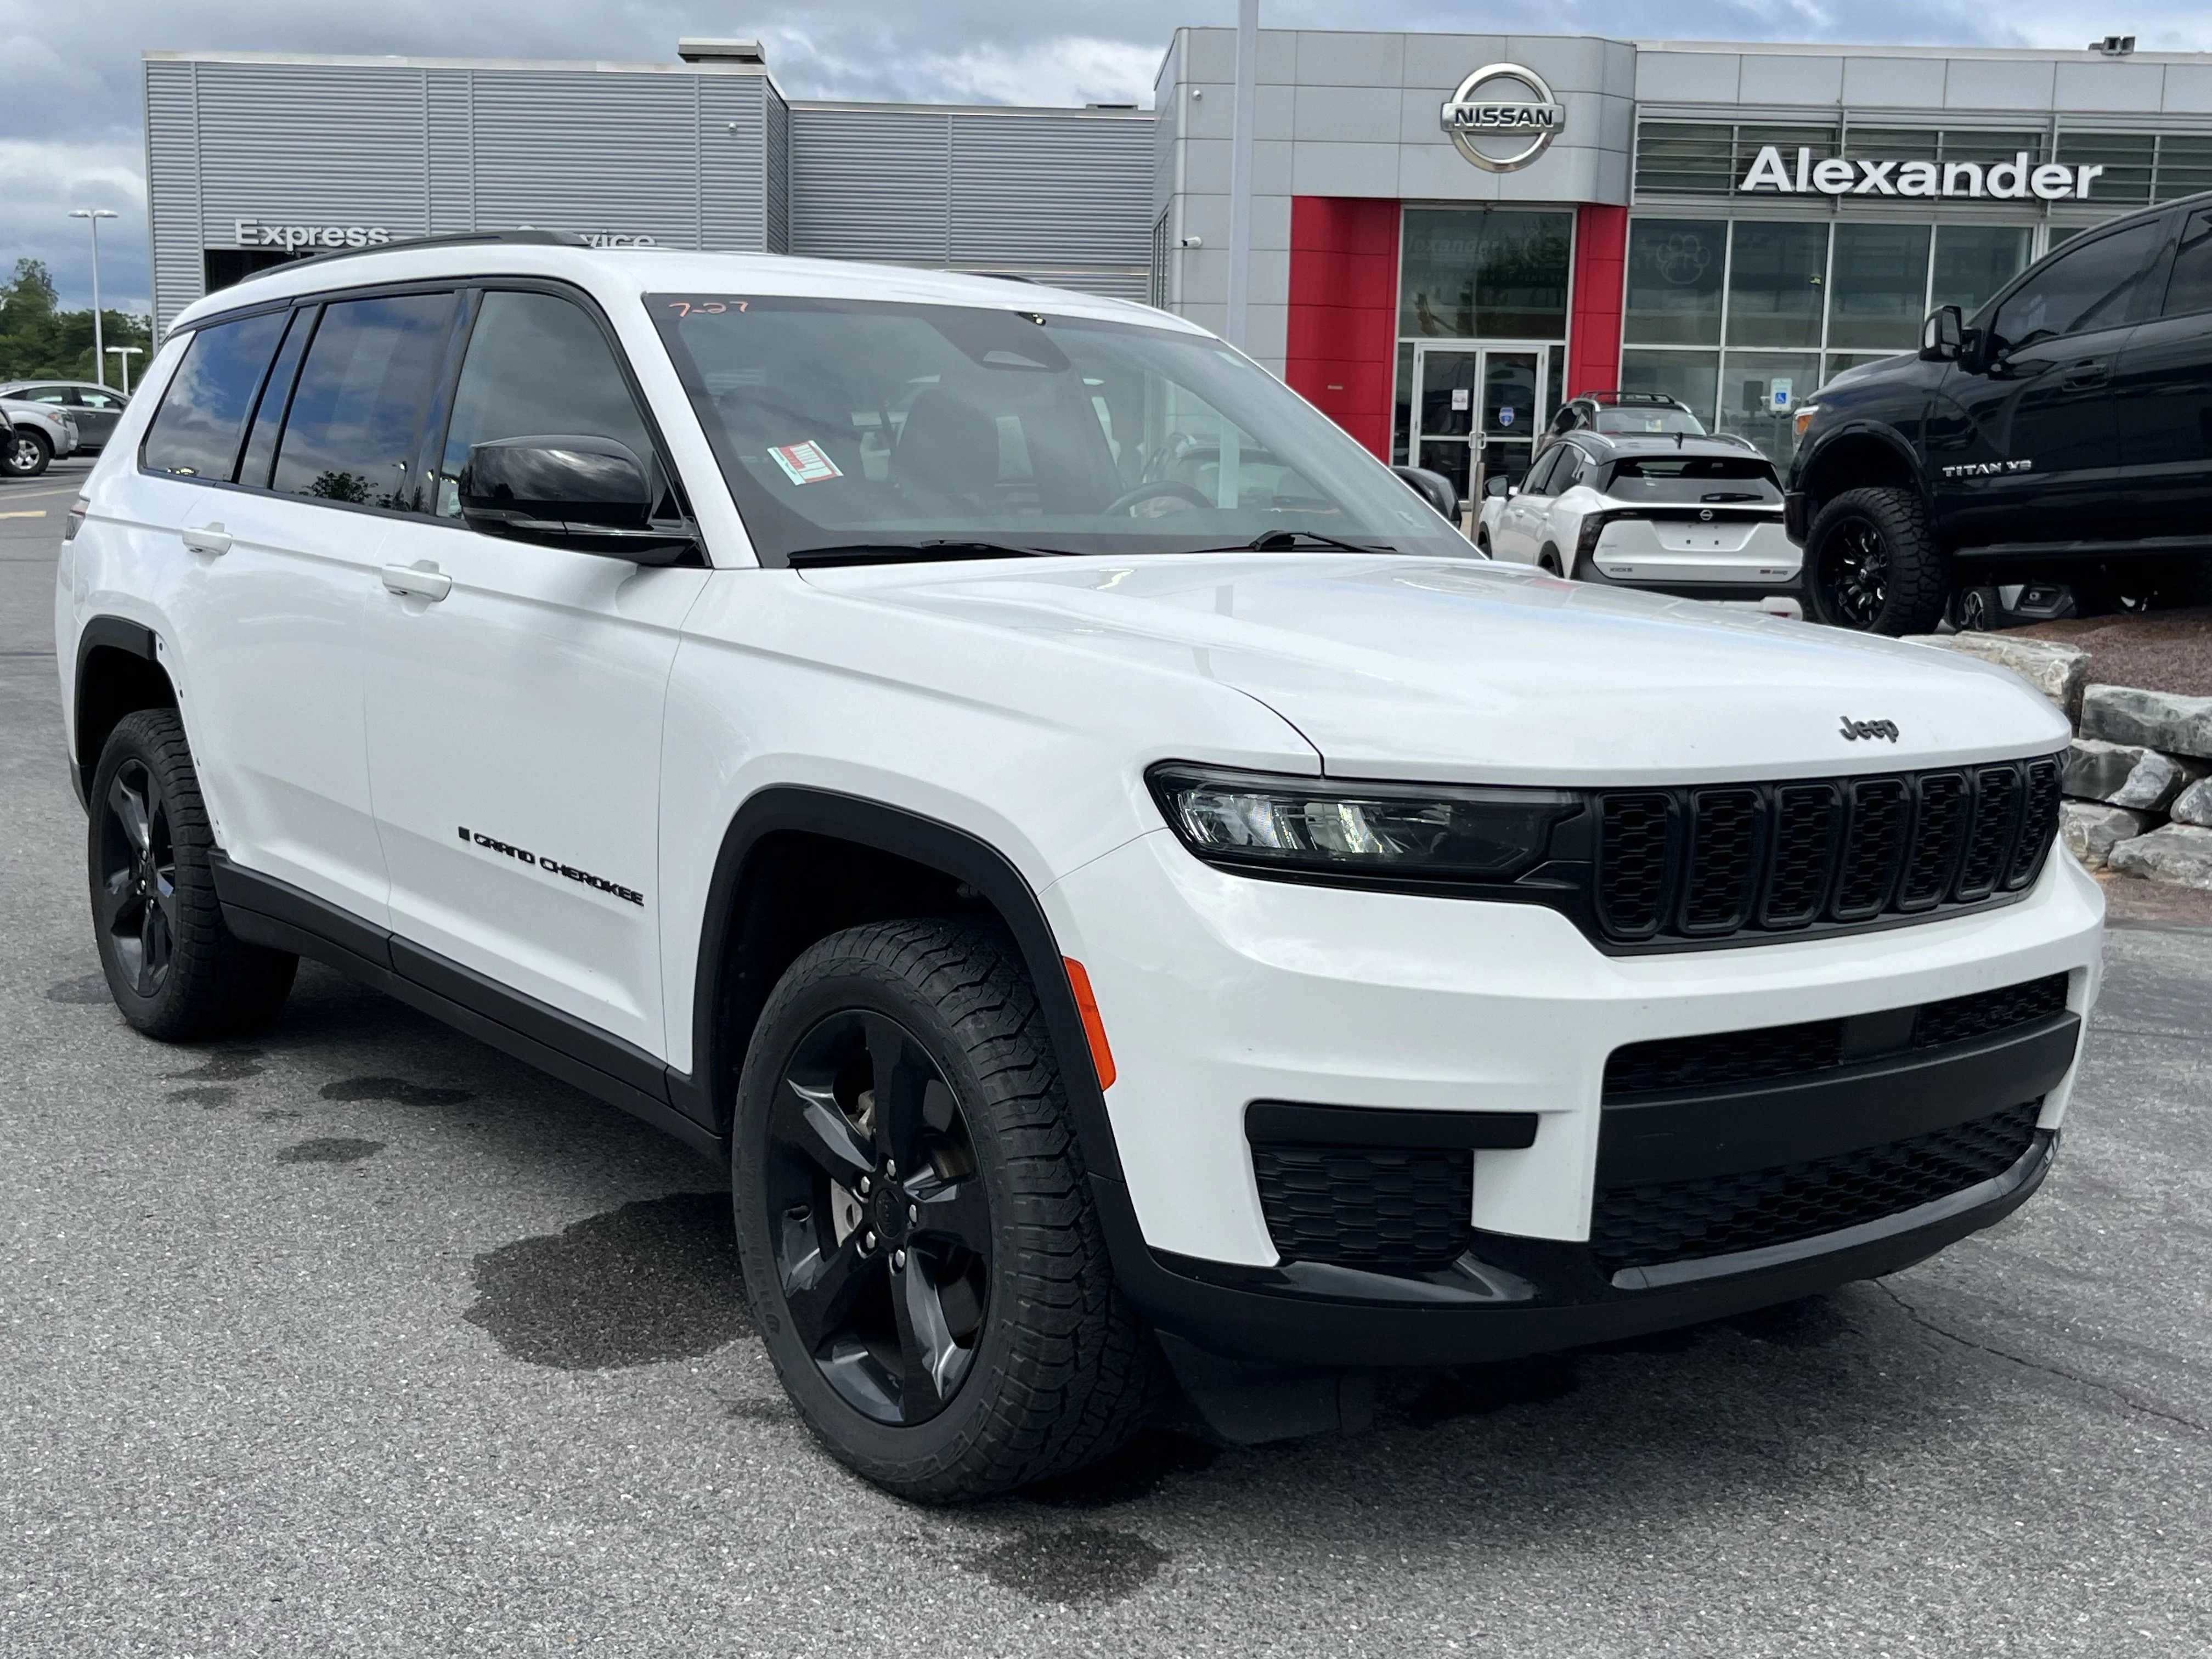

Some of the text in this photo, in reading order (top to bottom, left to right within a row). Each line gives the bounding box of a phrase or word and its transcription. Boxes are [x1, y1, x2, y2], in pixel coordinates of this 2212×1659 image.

[1455, 108, 1554, 127] NISSAN
[1740, 145, 2103, 199] Alexander
[235, 219, 390, 251] Express
[668, 301, 748, 318] 7-27
[1942, 462, 2002, 477] TITAN
[1839, 715, 1899, 743] Jeep
[473, 833, 644, 907] GRAND CHEROKEE
